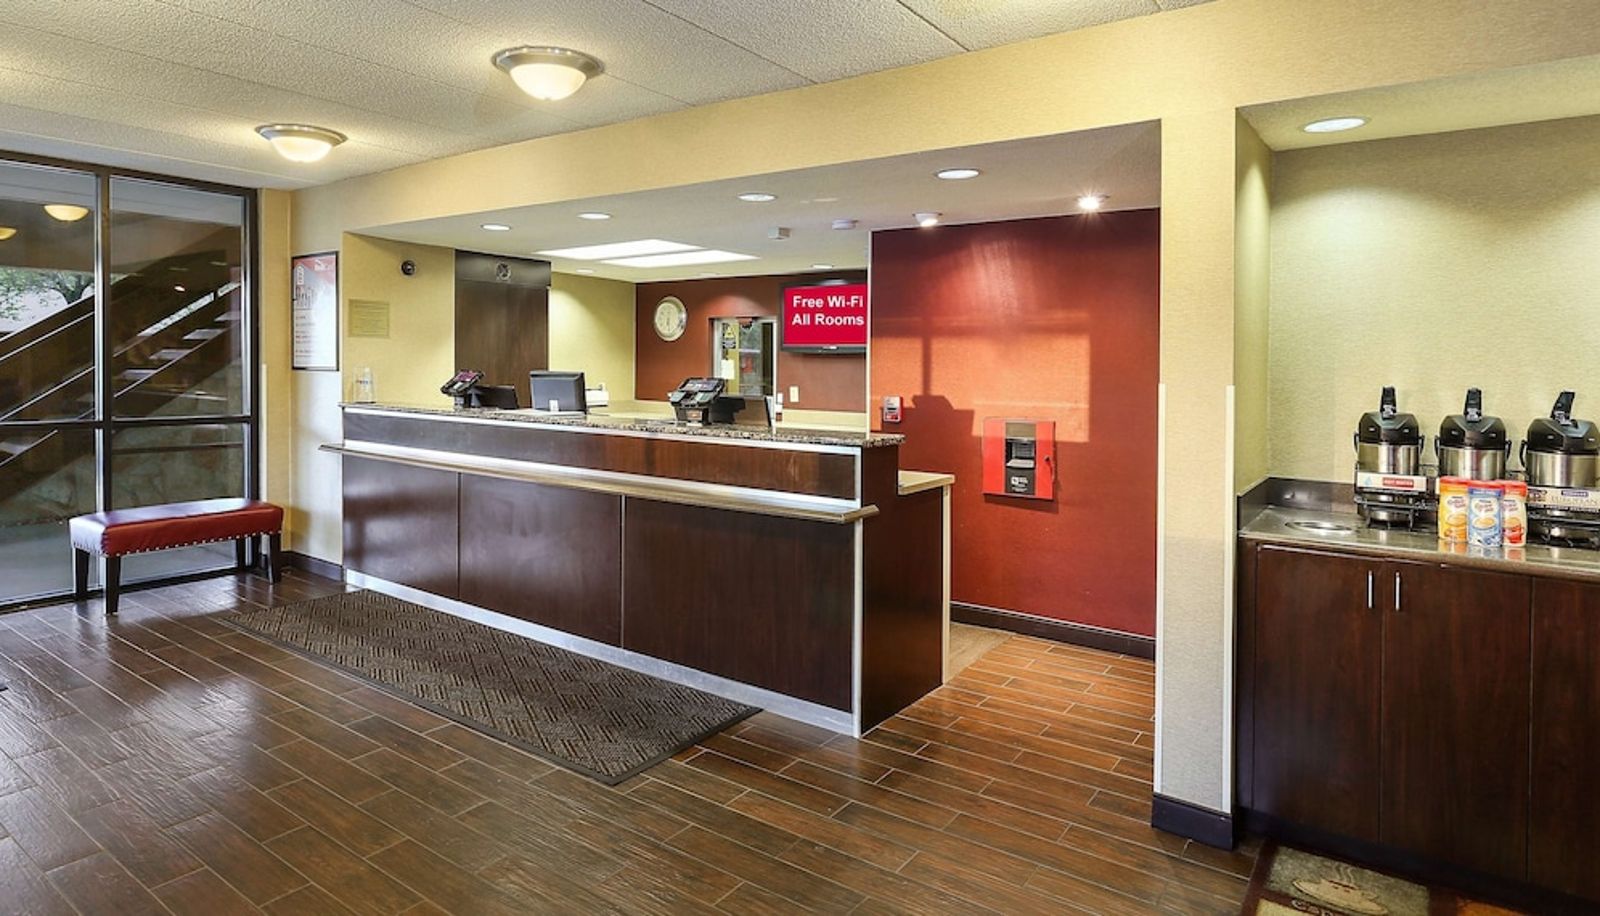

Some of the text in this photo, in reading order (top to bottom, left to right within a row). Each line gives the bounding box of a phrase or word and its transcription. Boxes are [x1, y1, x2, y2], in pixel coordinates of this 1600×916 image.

[793, 295, 864, 308] Free Wi-Fi
[792, 313, 865, 326] All Rooms
